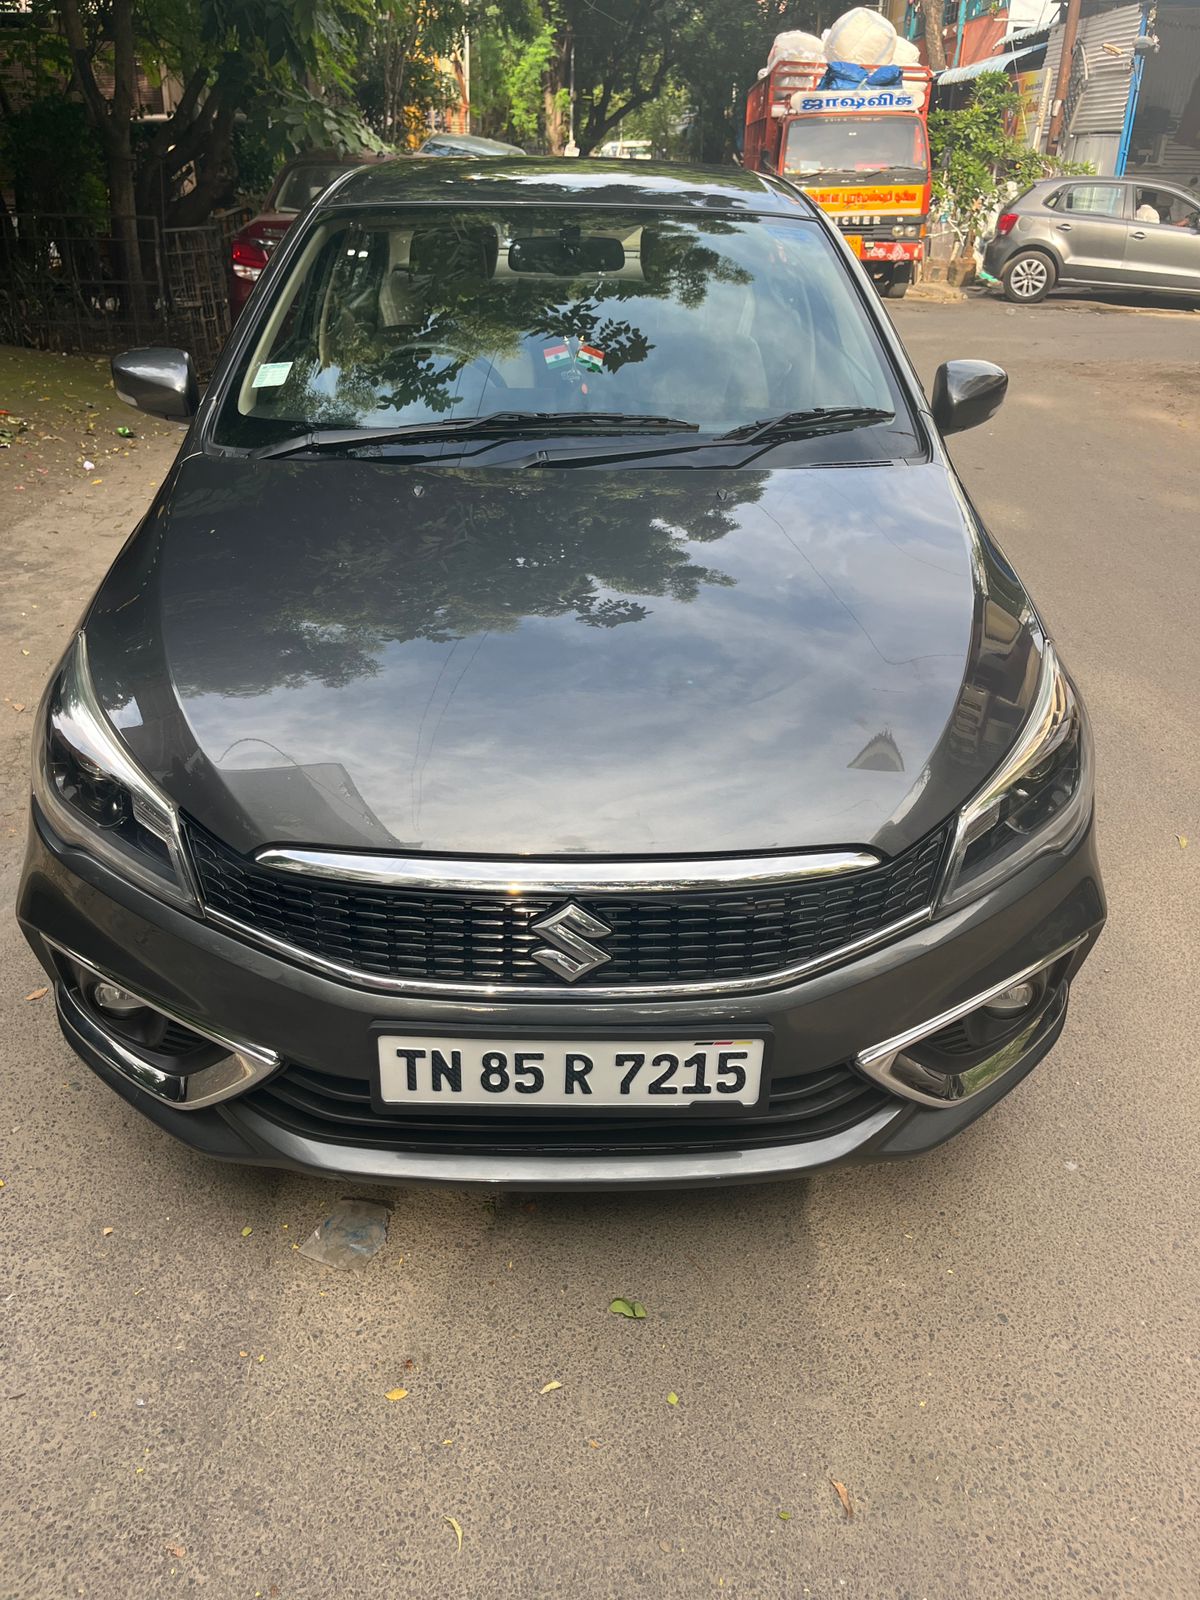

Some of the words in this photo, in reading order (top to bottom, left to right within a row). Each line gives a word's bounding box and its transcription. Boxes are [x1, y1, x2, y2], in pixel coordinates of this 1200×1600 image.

[834, 215, 881, 226] ICHER
[397, 1049, 462, 1092] TN
[480, 1052, 544, 1094] 85
[565, 1053, 594, 1095] R
[615, 1051, 748, 1095] 7215
